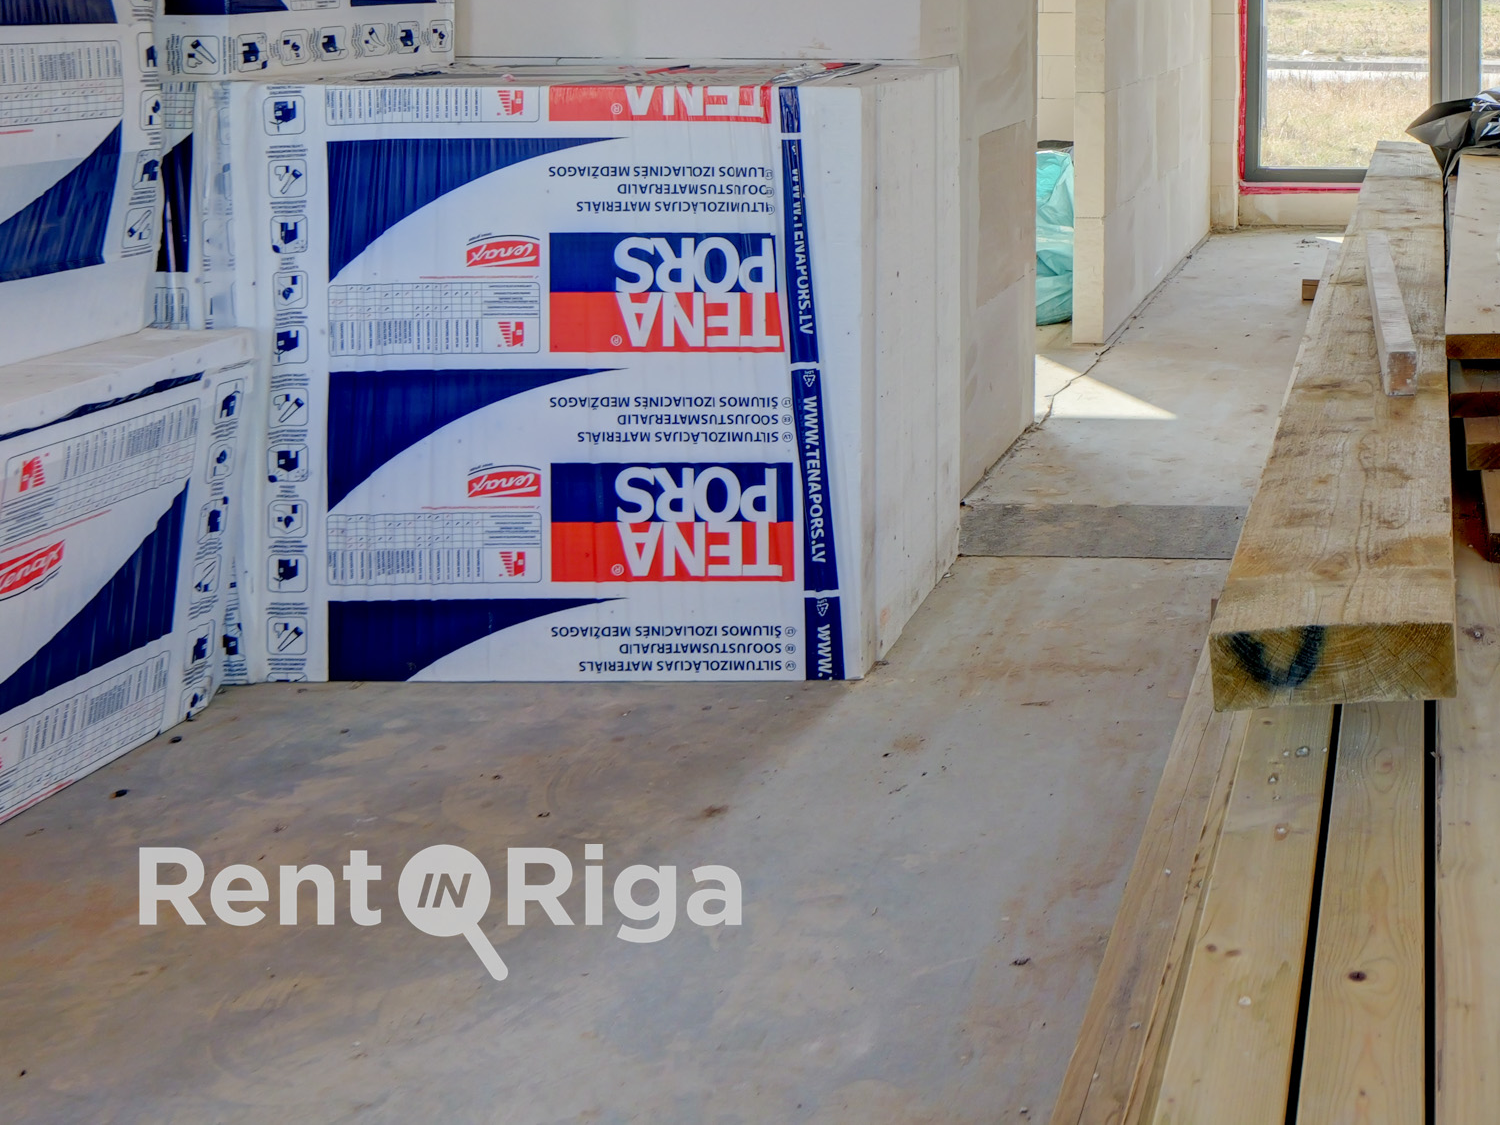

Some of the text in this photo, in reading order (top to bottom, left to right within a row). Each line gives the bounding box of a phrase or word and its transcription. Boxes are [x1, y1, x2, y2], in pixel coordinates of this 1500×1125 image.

[548, 166, 630, 179] MEDŽIAGOS
[576, 201, 650, 214] MATERIĀLS
[614, 237, 775, 294] PORS
[614, 292, 780, 347] TENA
[549, 396, 778, 410] ŠILUMOS IZOLIACINĖS MEDŽIAGOS
[617, 414, 779, 425] SOOJUSTUSMATERJALID
[577, 431, 779, 445] SILTUMIZOLĀCIJAS MATERIĀLS
[802, 395, 827, 564] WWW.TENAPORS.LV
[615, 466, 777, 523] PORS
[616, 522, 782, 576] TENA
[551, 626, 782, 639] ŠILUMOS IZOLIACINĖS MEDŽIAGOS
[619, 643, 782, 654] SOOJUSTUSMATERJALID
[578, 660, 782, 673] SILTUMIZOLĀCIJAS MATERIĀLS
